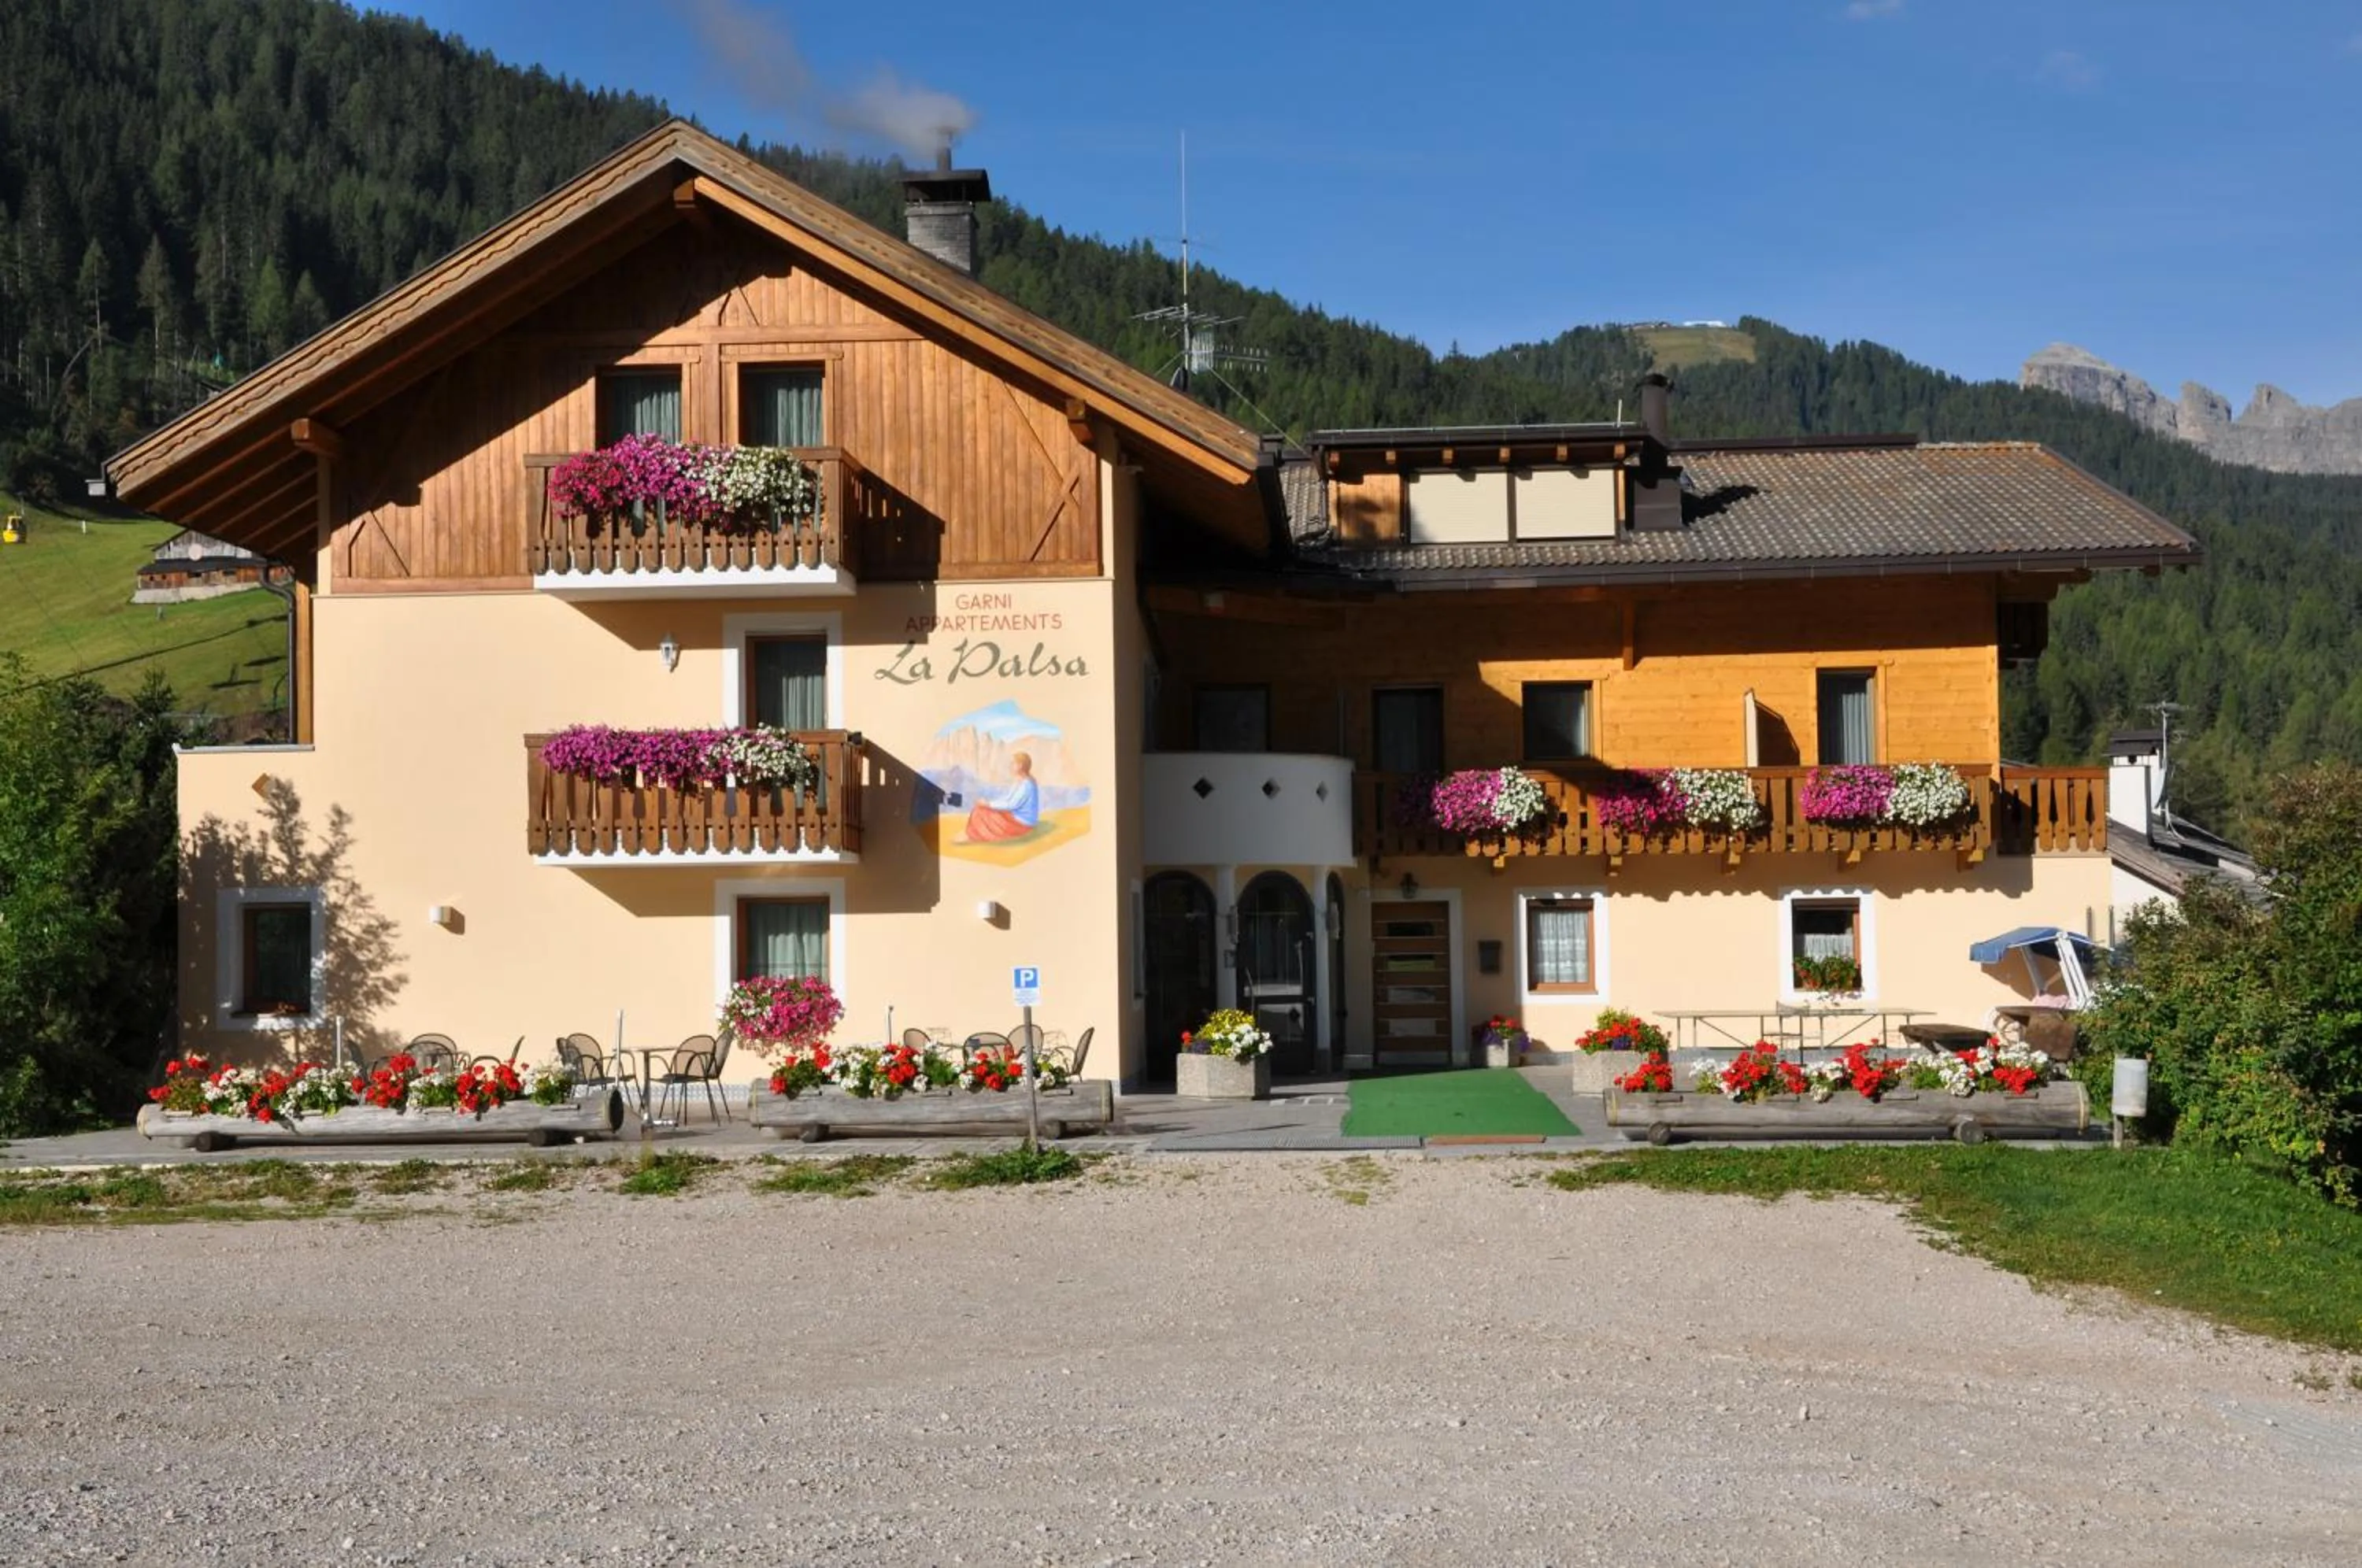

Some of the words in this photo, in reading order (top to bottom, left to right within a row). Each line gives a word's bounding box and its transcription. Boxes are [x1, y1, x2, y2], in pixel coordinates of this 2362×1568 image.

[955, 594, 1012, 610] GARNI
[906, 613, 1063, 631] APPARTEMENTS
[875, 640, 934, 685] La
[947, 638, 1090, 684] Palsa
[1020, 969, 1034, 987] P
